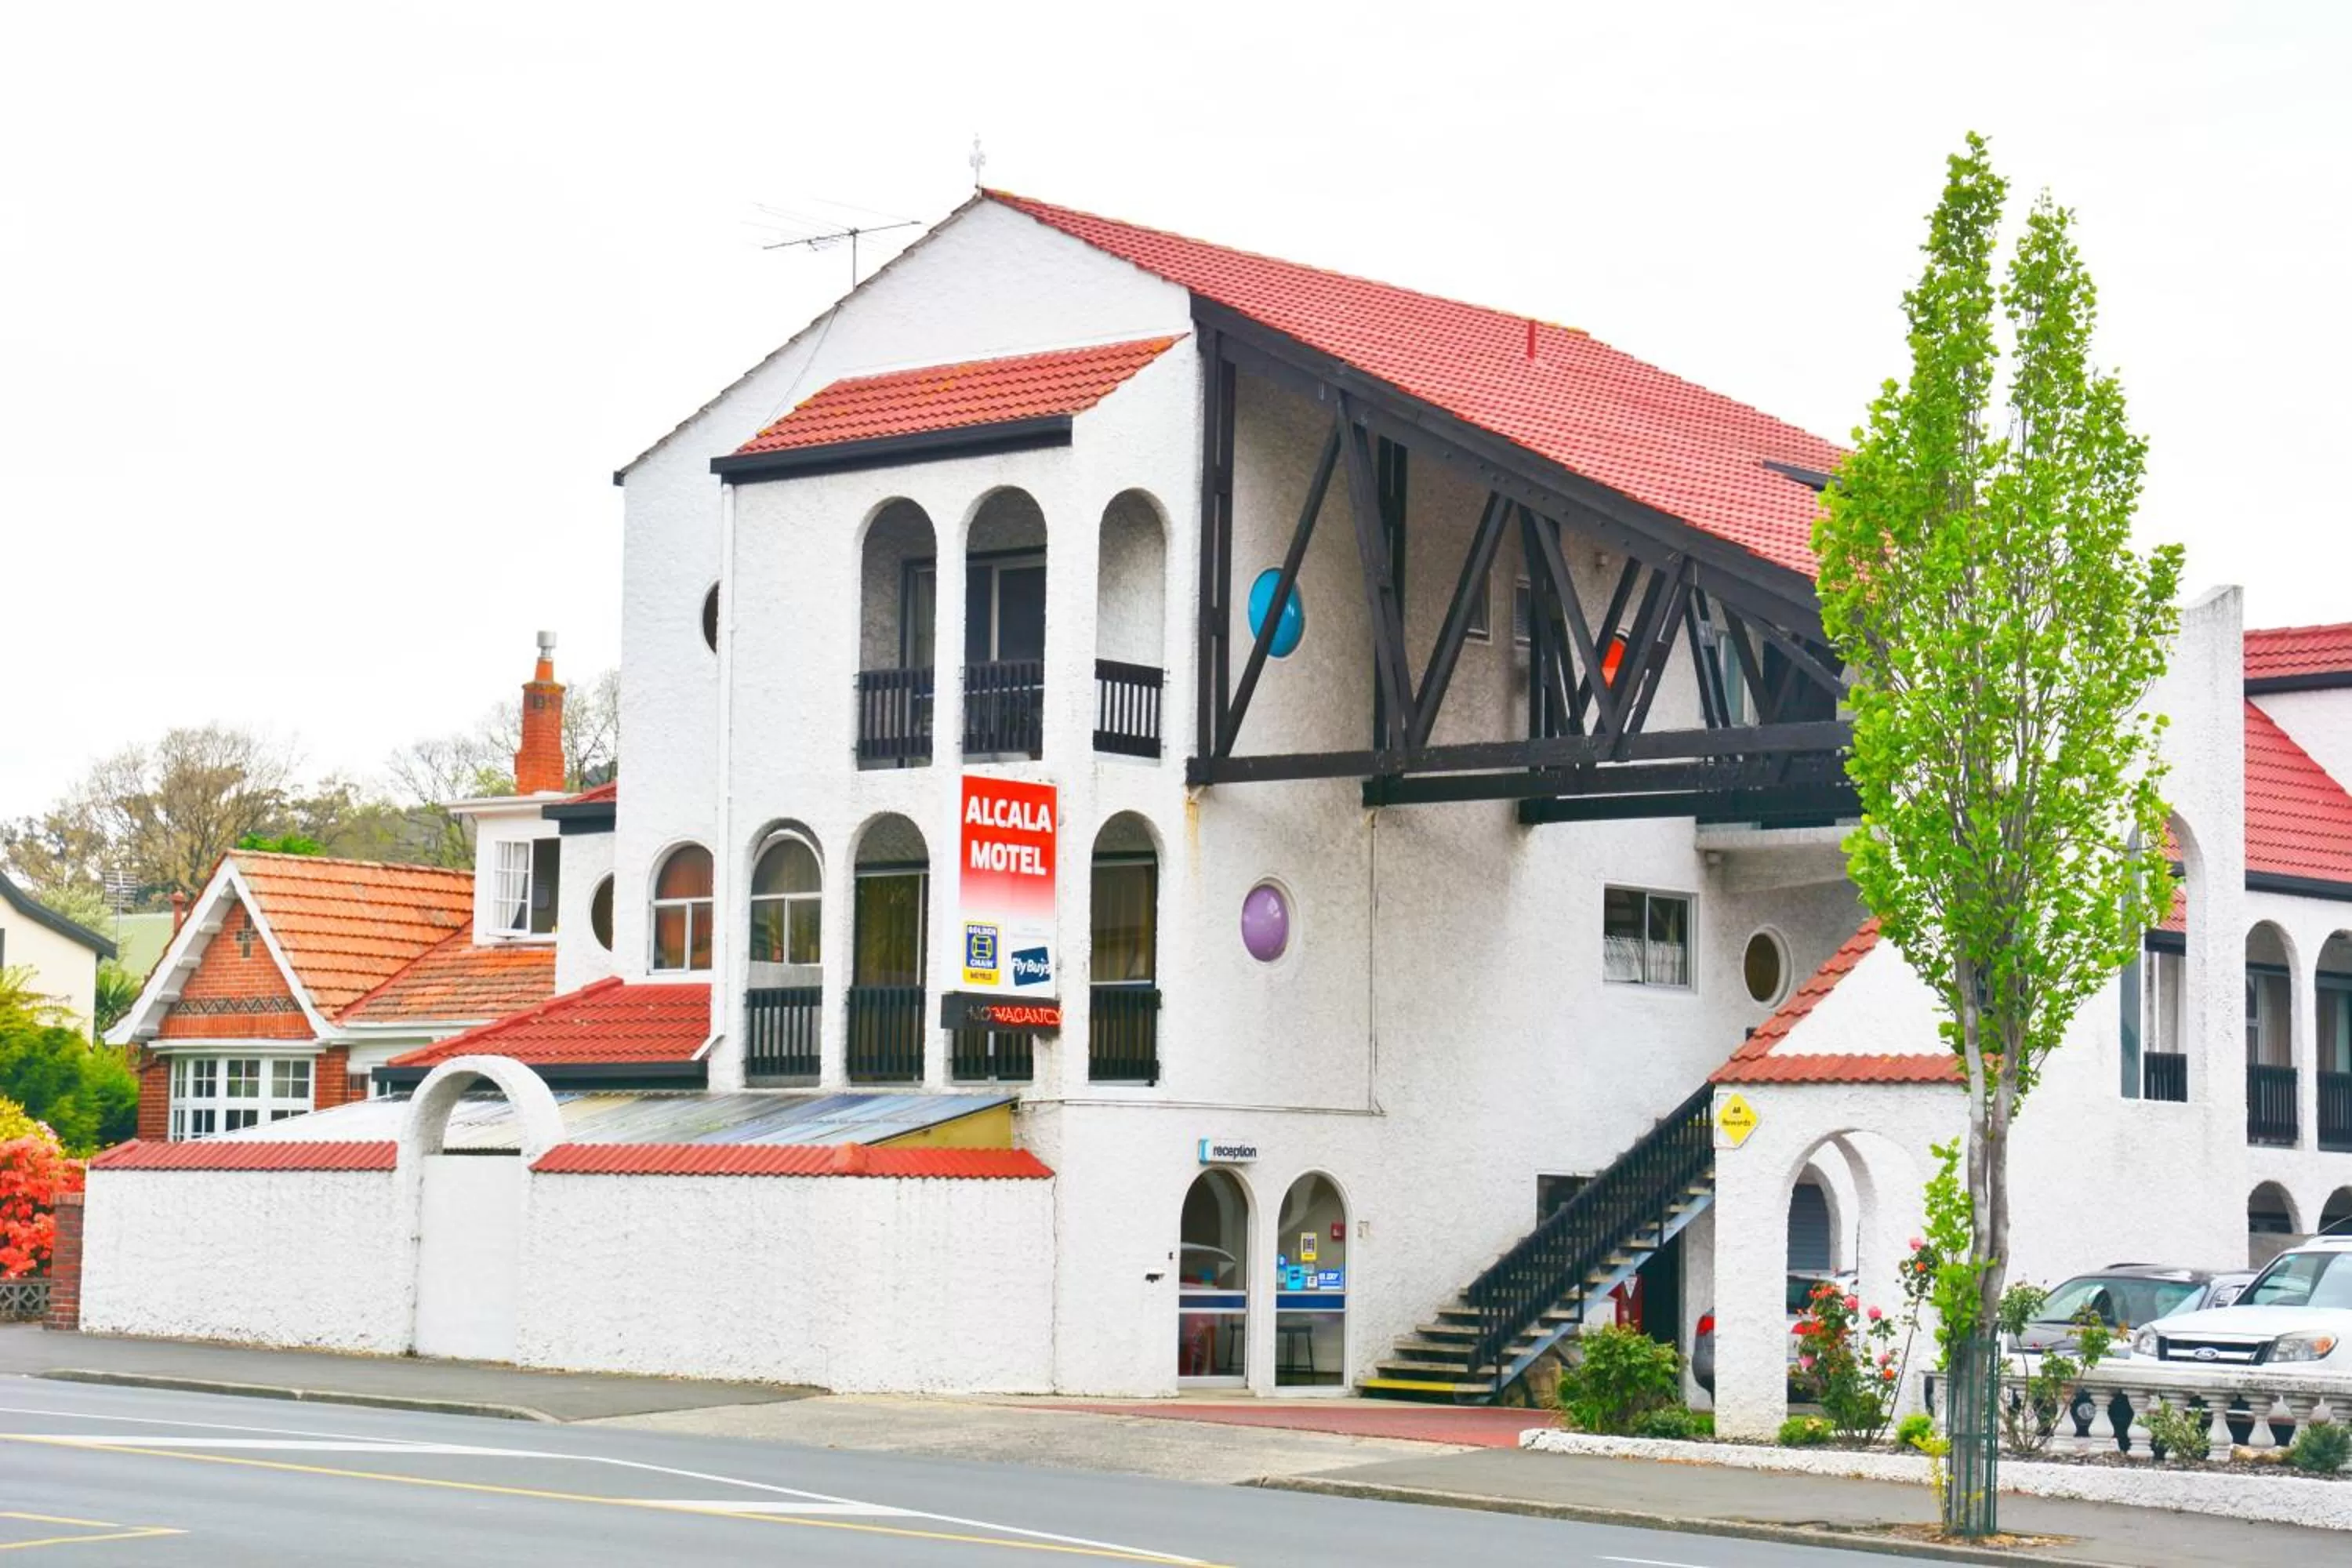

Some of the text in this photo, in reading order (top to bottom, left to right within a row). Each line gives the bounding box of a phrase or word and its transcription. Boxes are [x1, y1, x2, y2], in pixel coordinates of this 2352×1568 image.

[965, 795, 1053, 833] ALCALA
[970, 840, 1047, 876] MOTEL
[1011, 957, 1051, 978] FlyBuys
[1213, 1145, 1257, 1160] reception
